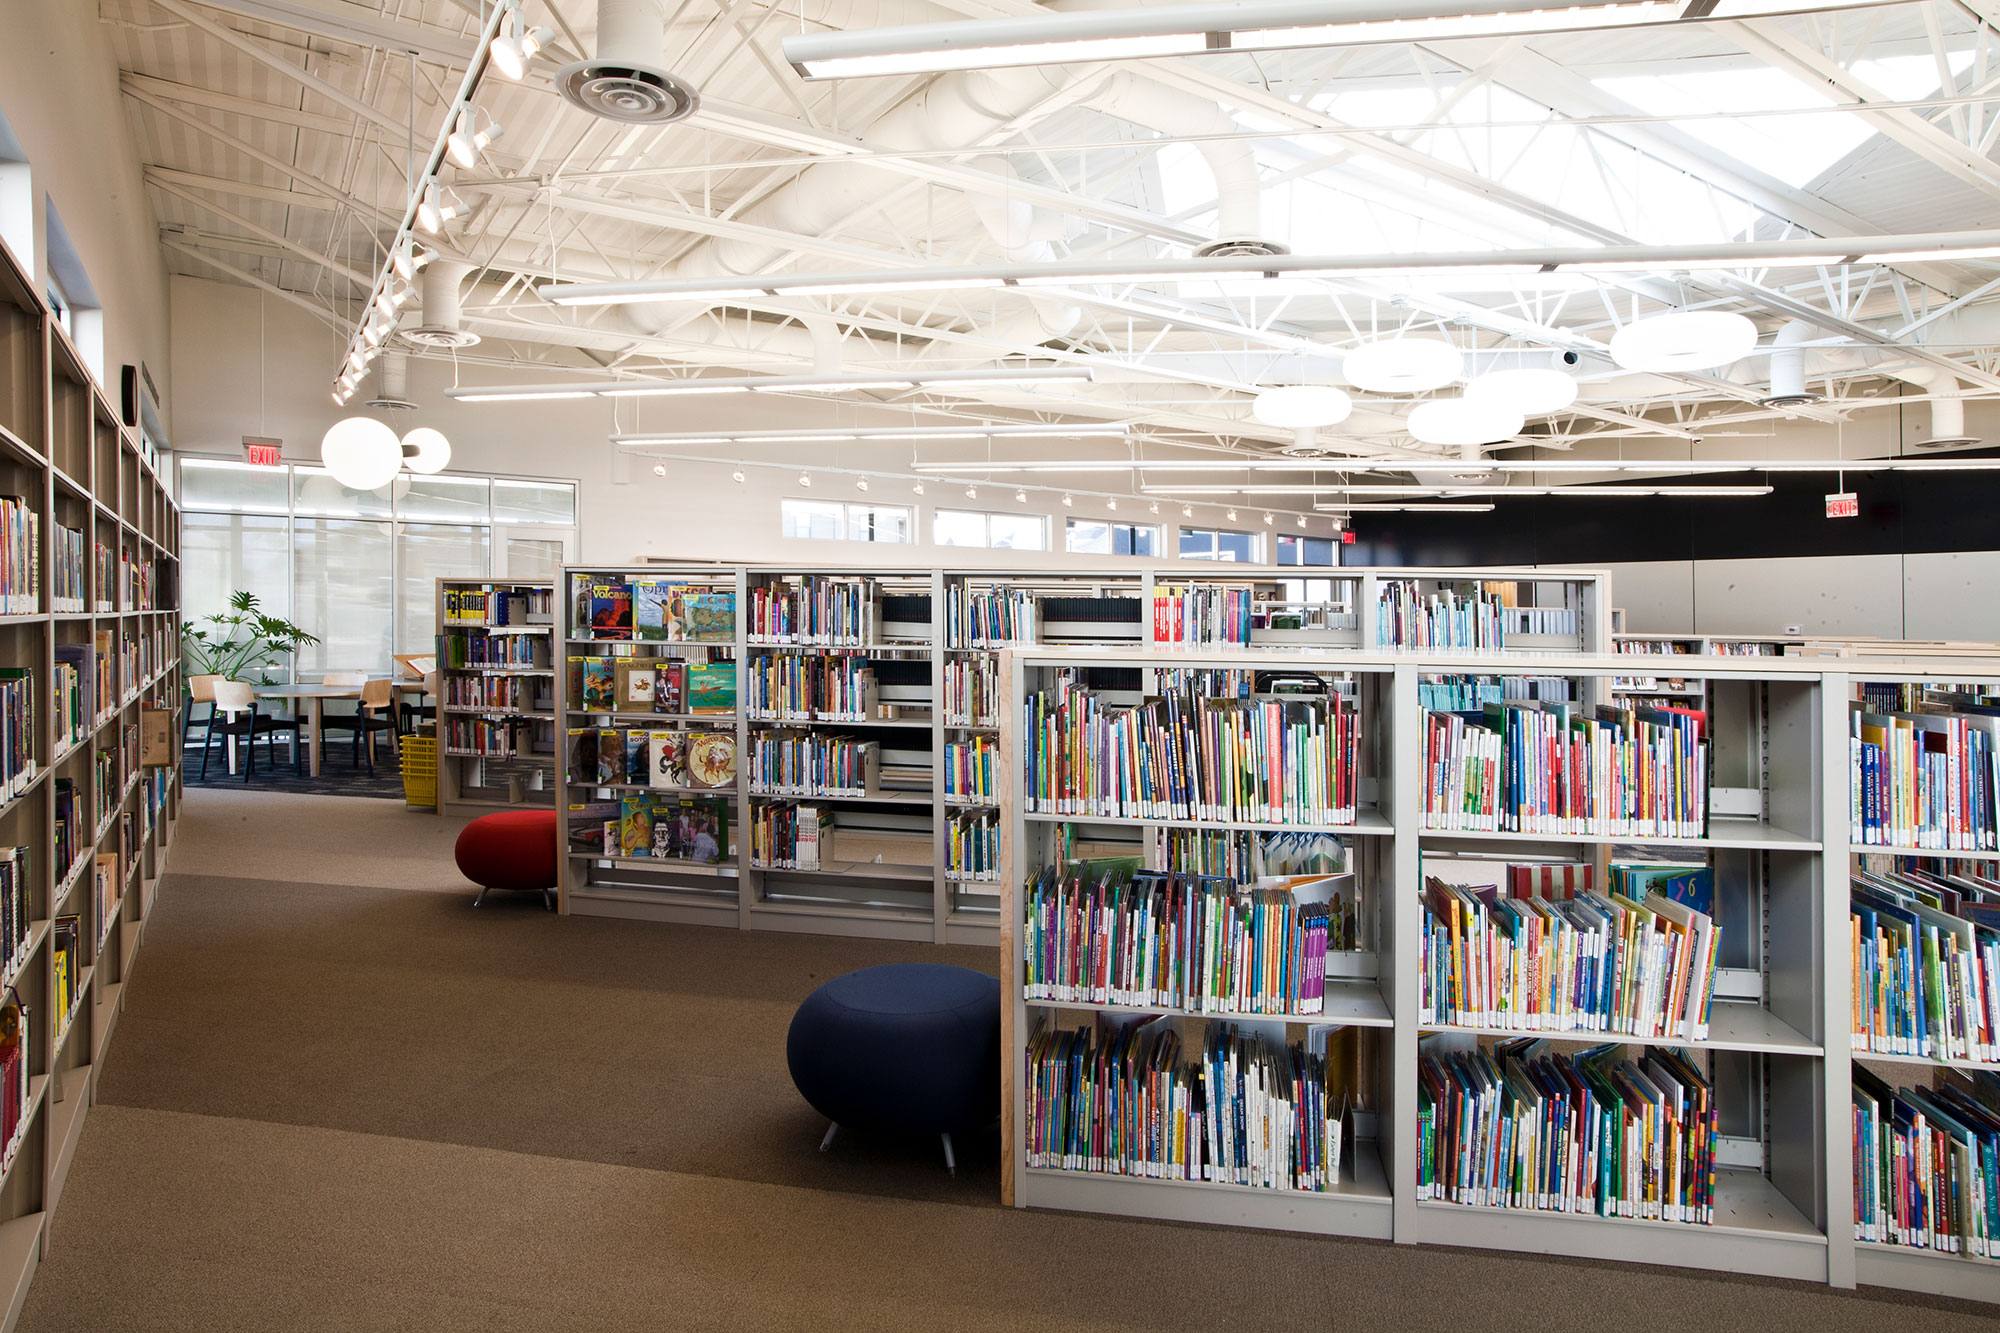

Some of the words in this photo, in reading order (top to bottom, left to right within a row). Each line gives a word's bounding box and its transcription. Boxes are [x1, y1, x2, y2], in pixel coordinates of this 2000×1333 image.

[249, 446, 276, 464] EXIT
[1832, 501, 1854, 516] EXIT
[593, 590, 632, 600] Volcano
[1688, 878, 1697, 897] 6
